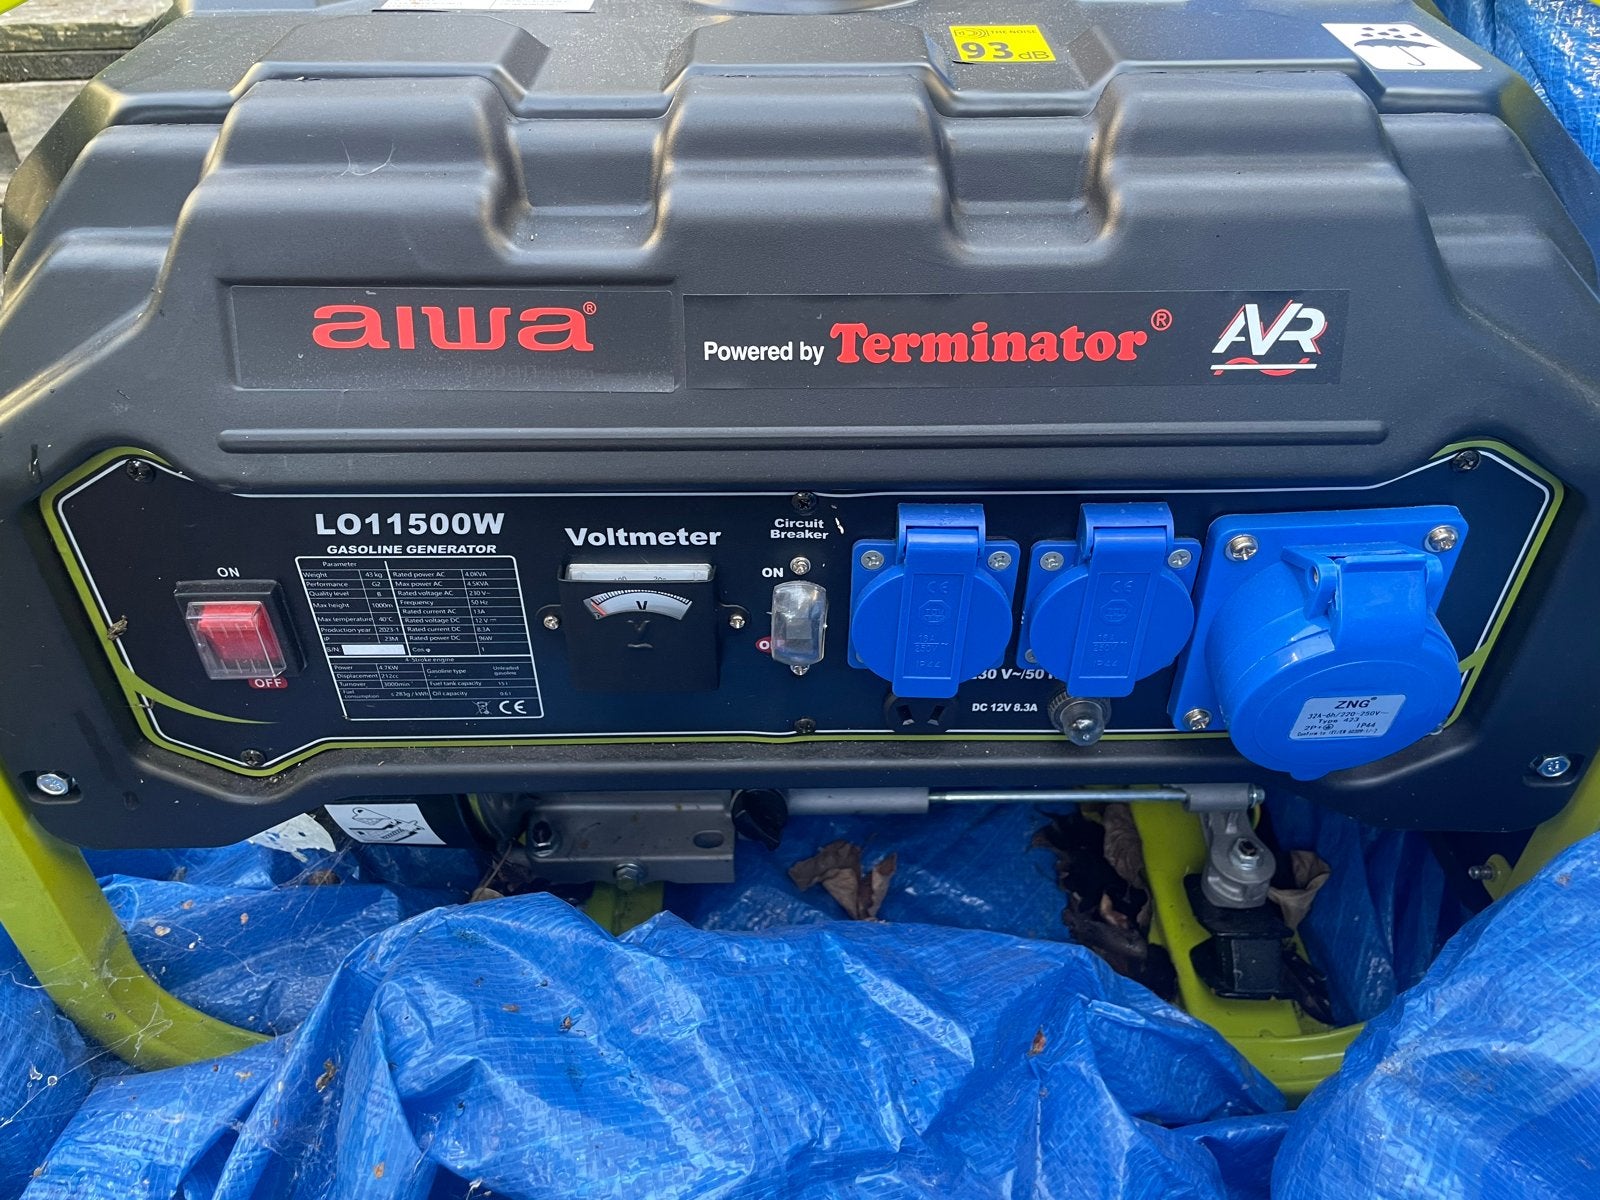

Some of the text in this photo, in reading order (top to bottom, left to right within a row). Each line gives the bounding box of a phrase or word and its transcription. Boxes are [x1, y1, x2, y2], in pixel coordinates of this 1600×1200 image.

[961, 42, 1049, 59] 93 dB
[1212, 300, 1328, 355] AVR
[703, 341, 793, 361] Powered
[799, 341, 825, 365] by
[315, 512, 505, 535] LO11500W
[774, 518, 825, 528] Circuit
[564, 527, 722, 546] Voltmeter
[770, 529, 829, 540] Breaker
[326, 544, 497, 554] GASOLINE GENERATOR
[216, 567, 240, 578] ON
[761, 568, 784, 578] ON
[636, 600, 647, 610] V
[970, 668, 998, 680] 30
[254, 679, 282, 688] OFF
[972, 703, 1038, 712] DC 12V 8.3A
